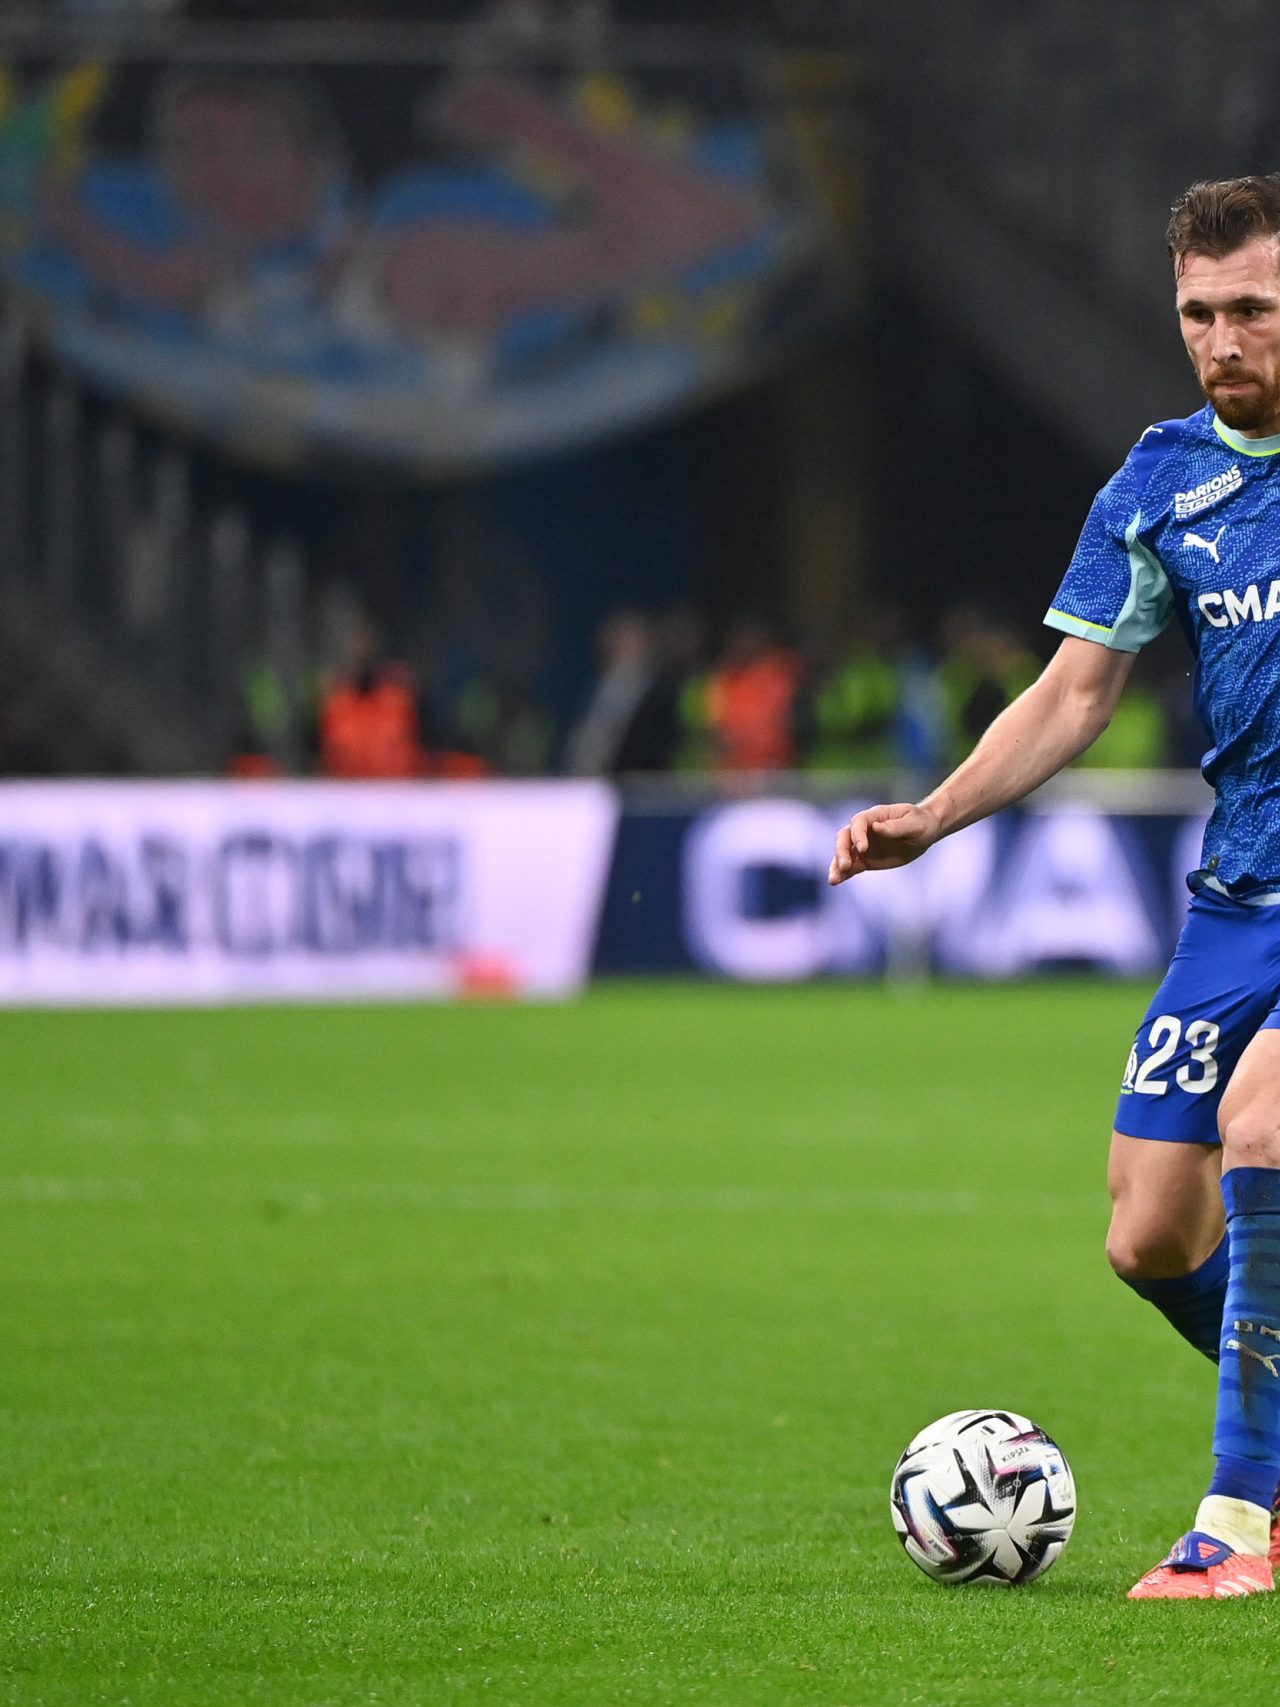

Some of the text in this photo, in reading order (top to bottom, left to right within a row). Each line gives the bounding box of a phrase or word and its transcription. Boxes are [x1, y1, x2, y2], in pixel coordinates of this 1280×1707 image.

[1175, 464, 1241, 503] PARIONS
[1178, 478, 1242, 513] SPORT
[1134, 1015, 1220, 1095] 23
[1001, 1446, 1030, 1463] KIPSTA
